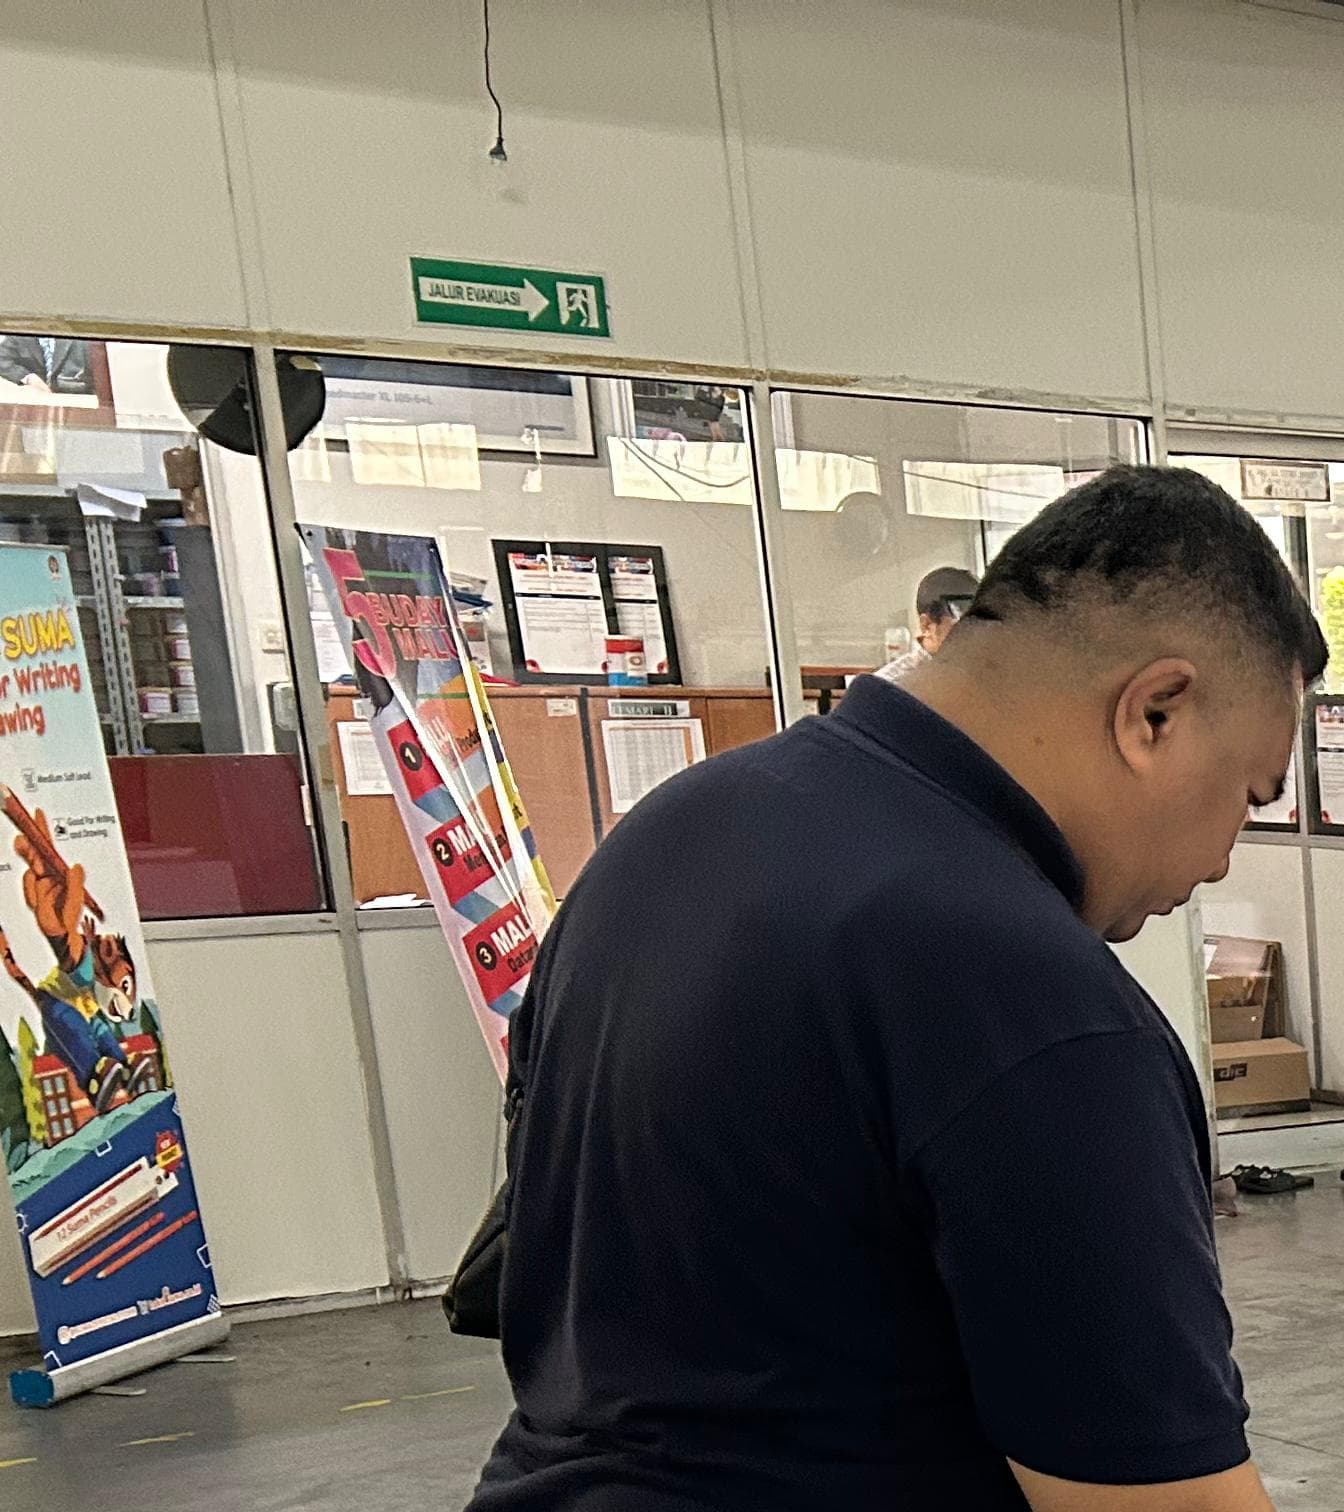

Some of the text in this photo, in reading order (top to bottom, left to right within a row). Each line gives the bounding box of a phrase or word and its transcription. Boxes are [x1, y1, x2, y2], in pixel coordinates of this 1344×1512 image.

[429, 283, 521, 306] JALUR EVAKUASI
[366, 591, 452, 628] BUDAY
[0, 607, 76, 661] SUMA
[13, 660, 81, 694] Writing
[404, 746, 417, 764] 1
[435, 844, 450, 861] 2
[479, 913, 534, 964] 3 MAL
